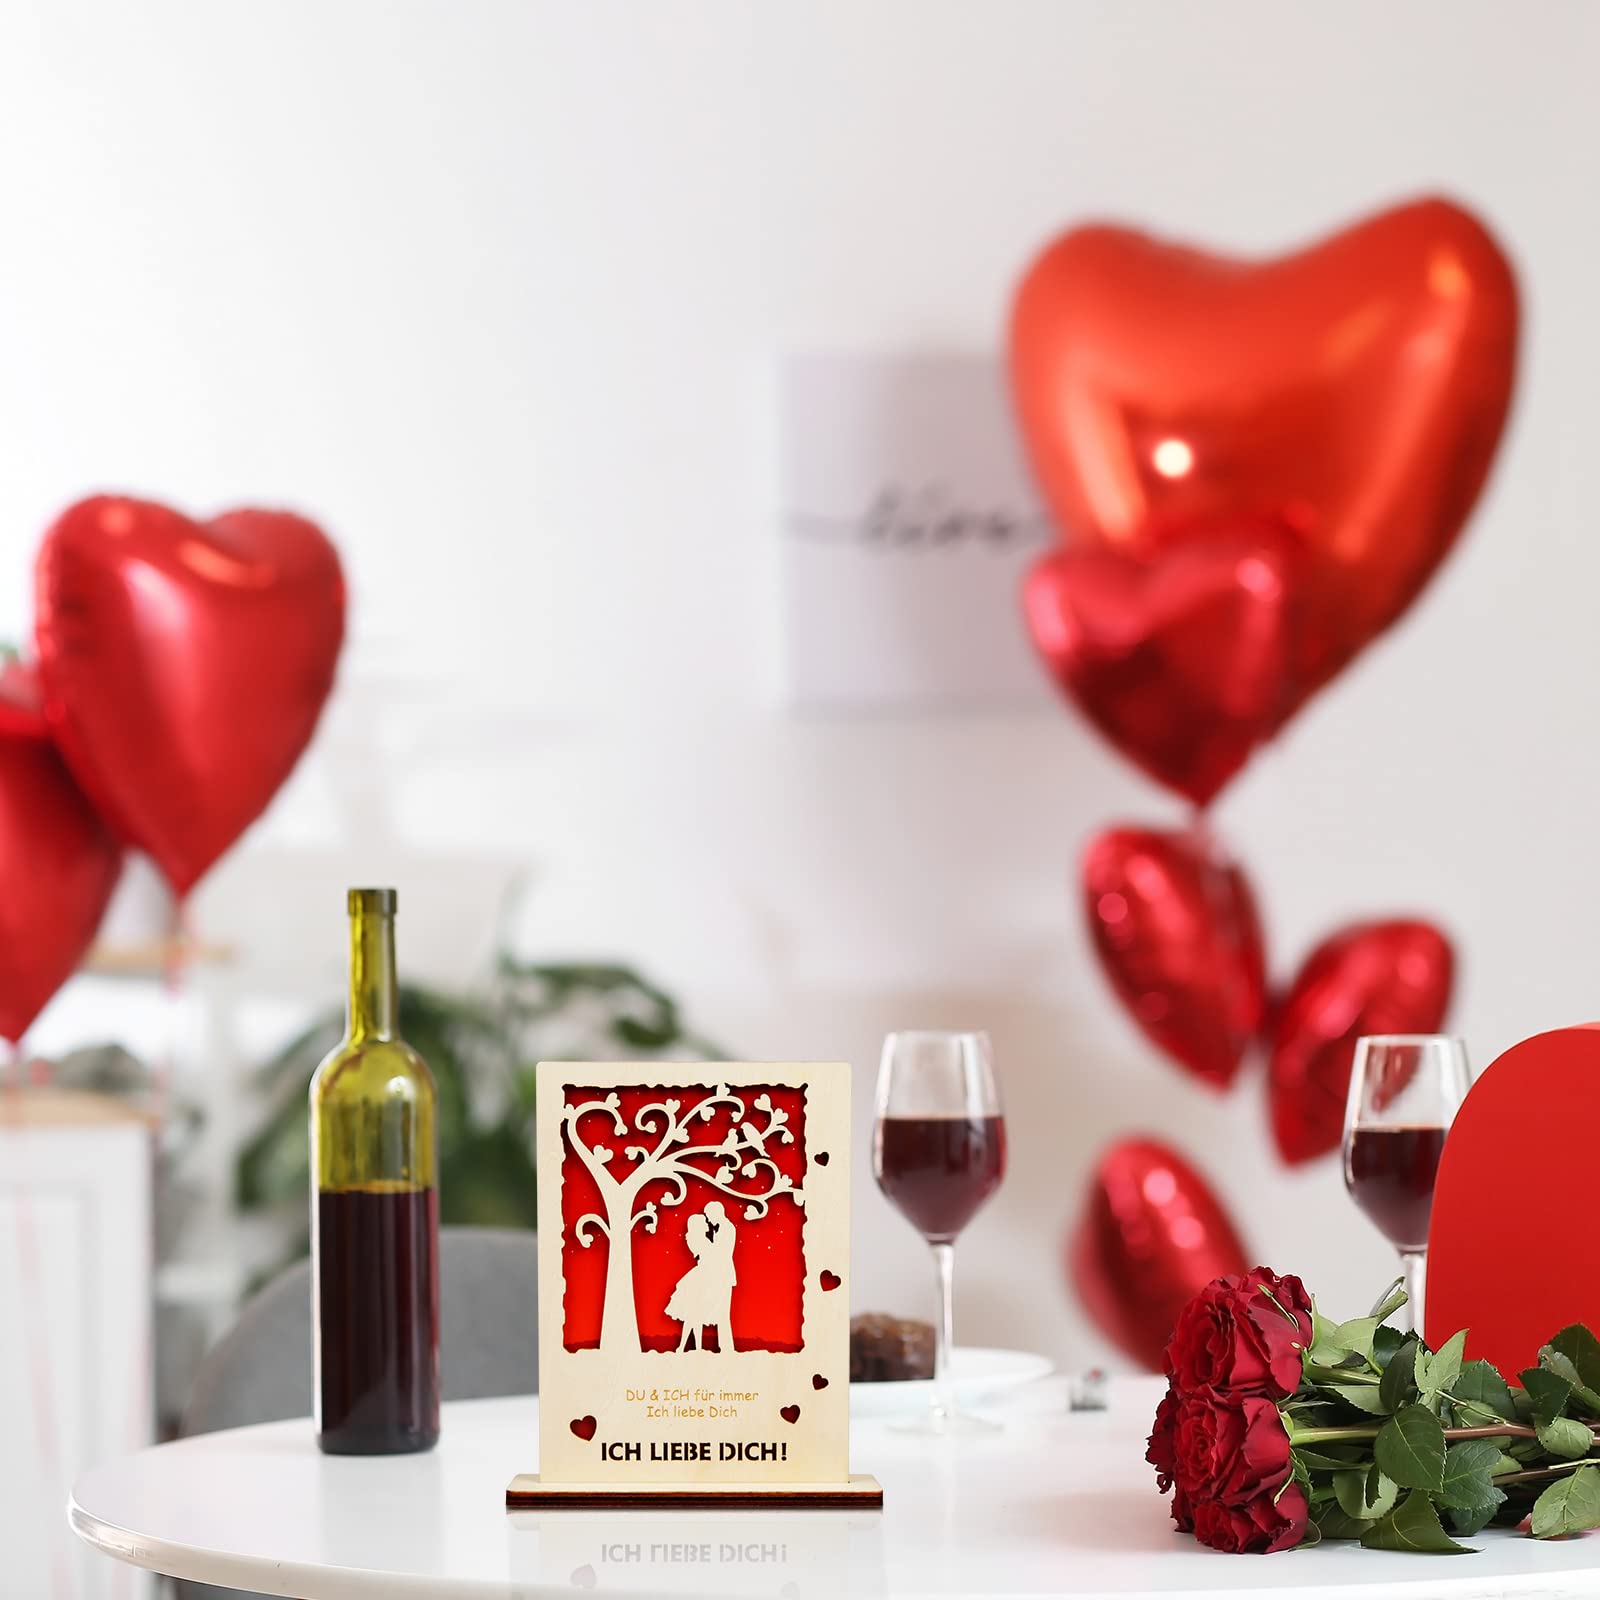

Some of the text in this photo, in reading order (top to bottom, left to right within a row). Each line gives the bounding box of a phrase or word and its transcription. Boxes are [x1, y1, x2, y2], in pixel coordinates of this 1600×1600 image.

[626, 1388, 759, 1402] DU & ICH für immer
[646, 1405, 738, 1418] Ich liebe Dich
[601, 1442, 788, 1461] ICH LIEBE DICH!
